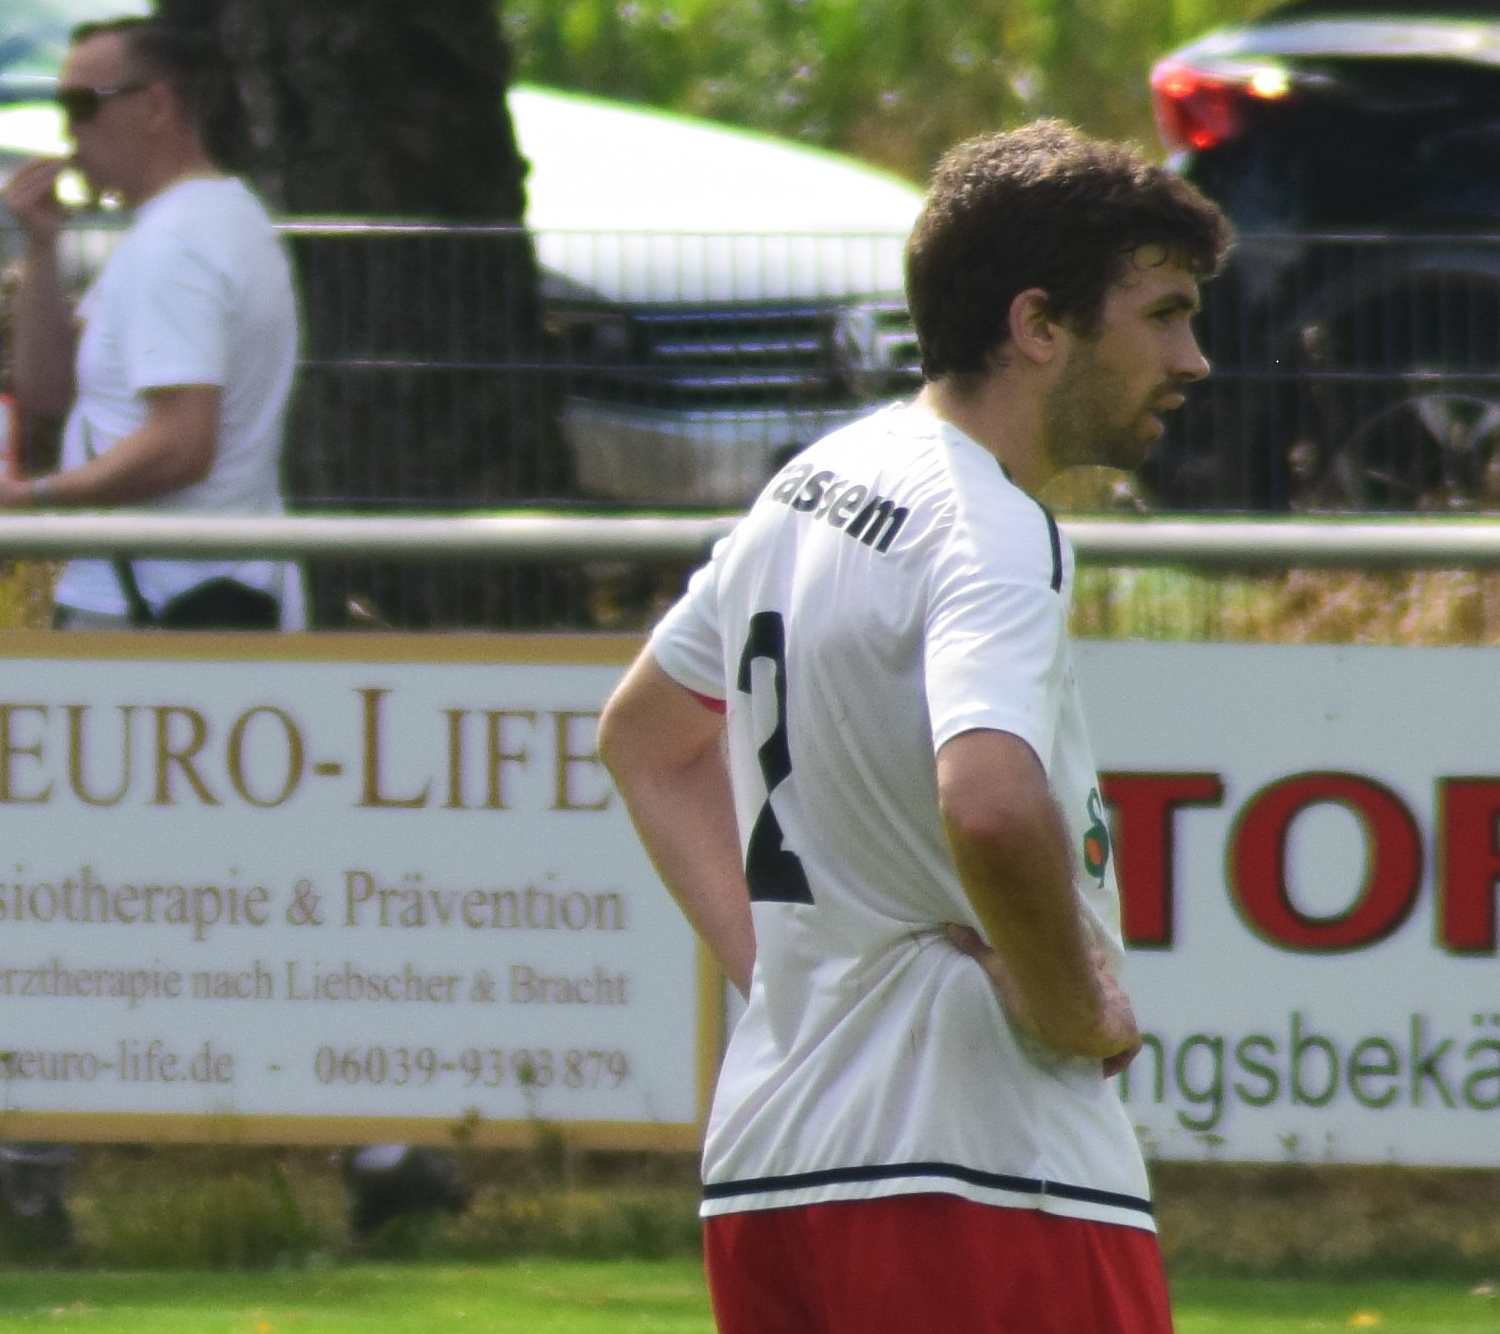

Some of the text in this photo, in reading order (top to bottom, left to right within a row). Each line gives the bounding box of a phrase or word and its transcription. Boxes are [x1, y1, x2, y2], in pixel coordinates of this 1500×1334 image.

[737, 610, 815, 905] 2
[286, 878, 325, 929] &
[343, 869, 627, 932] Prävention
[191, 960, 274, 1000] nach
[285, 959, 460, 1003] Liebscher
[471, 968, 497, 1003] &
[509, 964, 628, 1006] Bracht
